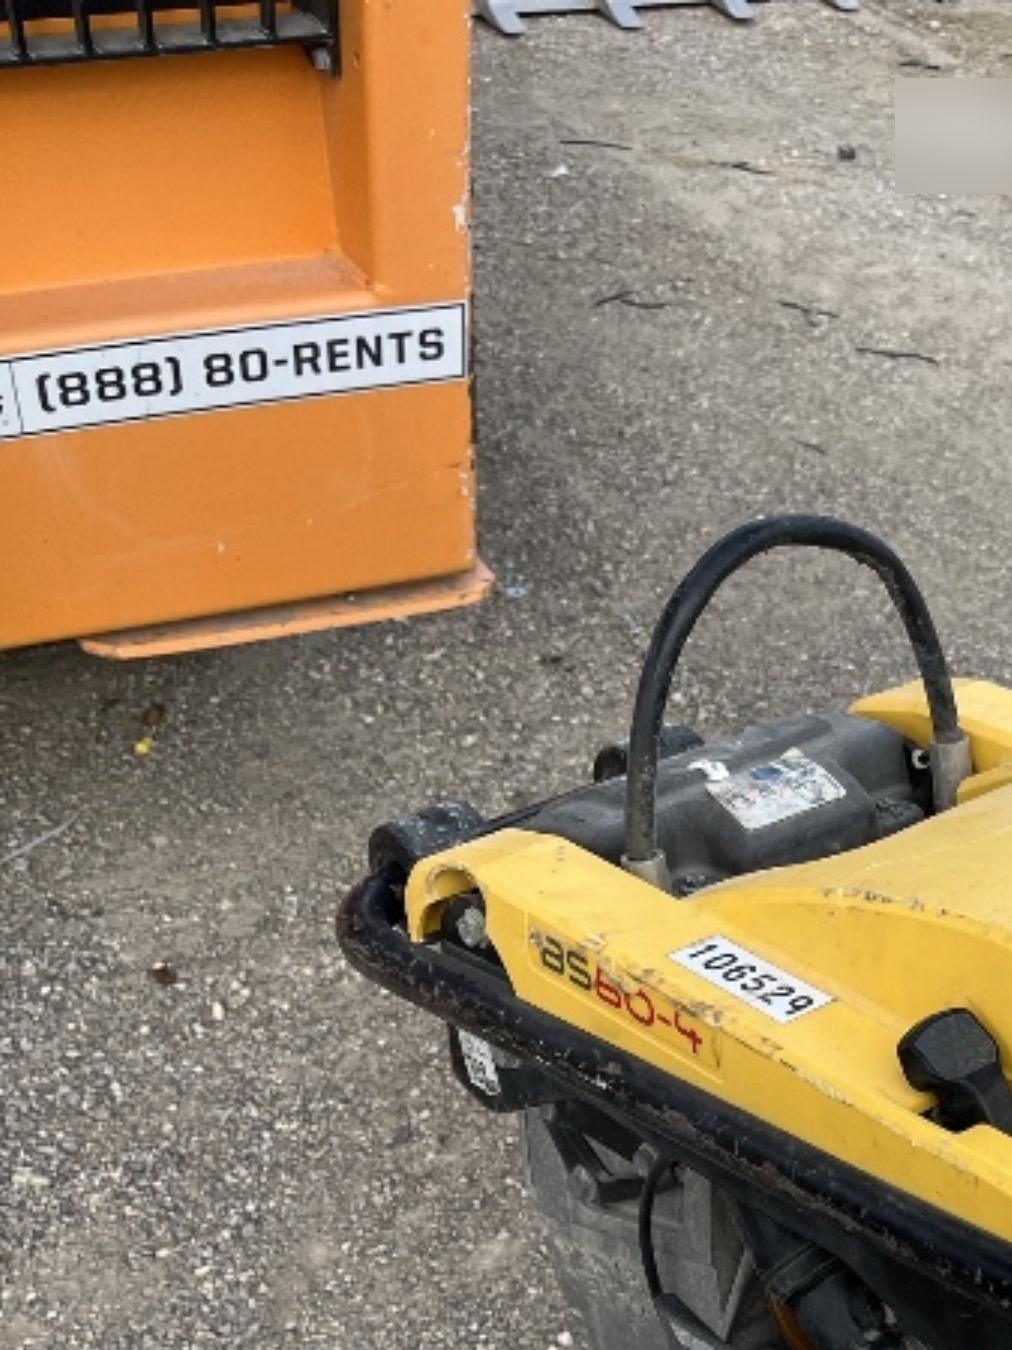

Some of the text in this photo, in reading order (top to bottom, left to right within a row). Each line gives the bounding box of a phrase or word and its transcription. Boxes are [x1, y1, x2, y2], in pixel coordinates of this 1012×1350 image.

[36, 327, 446, 414] (888) 80-RENTS
[688, 944, 814, 1016] 106529
